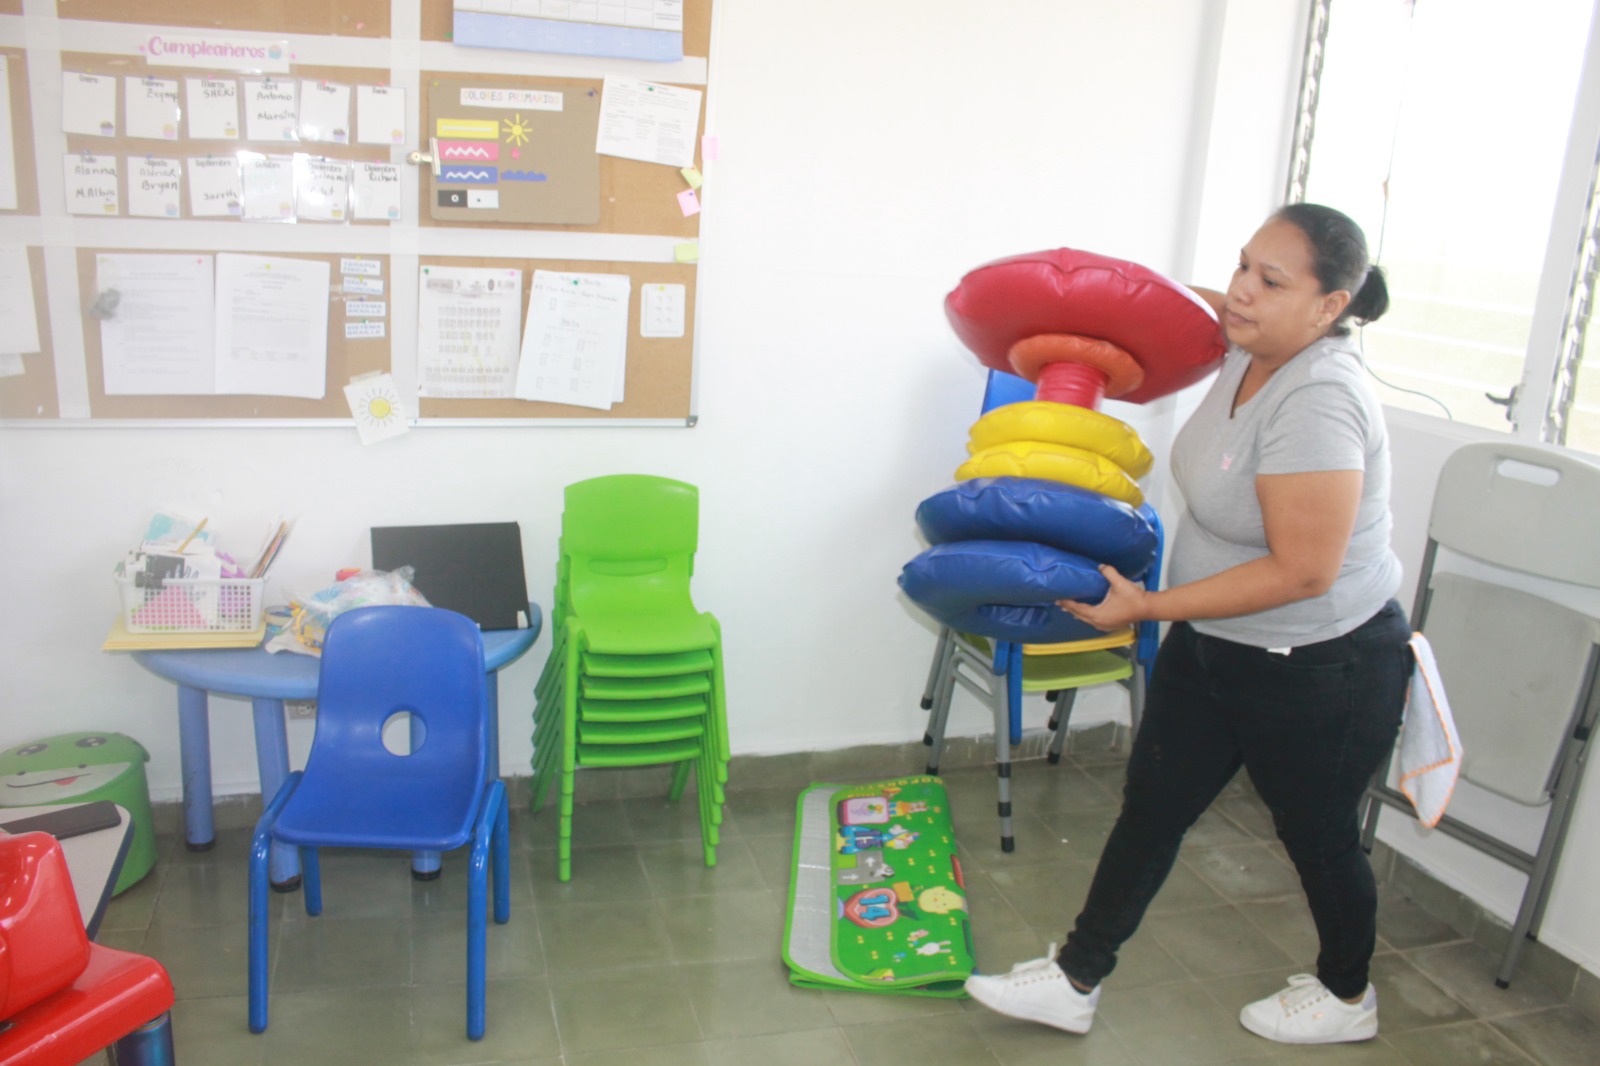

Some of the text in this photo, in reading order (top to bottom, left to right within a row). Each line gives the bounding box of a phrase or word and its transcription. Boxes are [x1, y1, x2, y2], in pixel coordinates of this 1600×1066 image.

[148, 36, 266, 59] Cumpleañeros
[463, 90, 560, 105] COLORES PRIMARIOS
[141, 180, 178, 195] Bryan
[859, 893, 891, 921] 14
